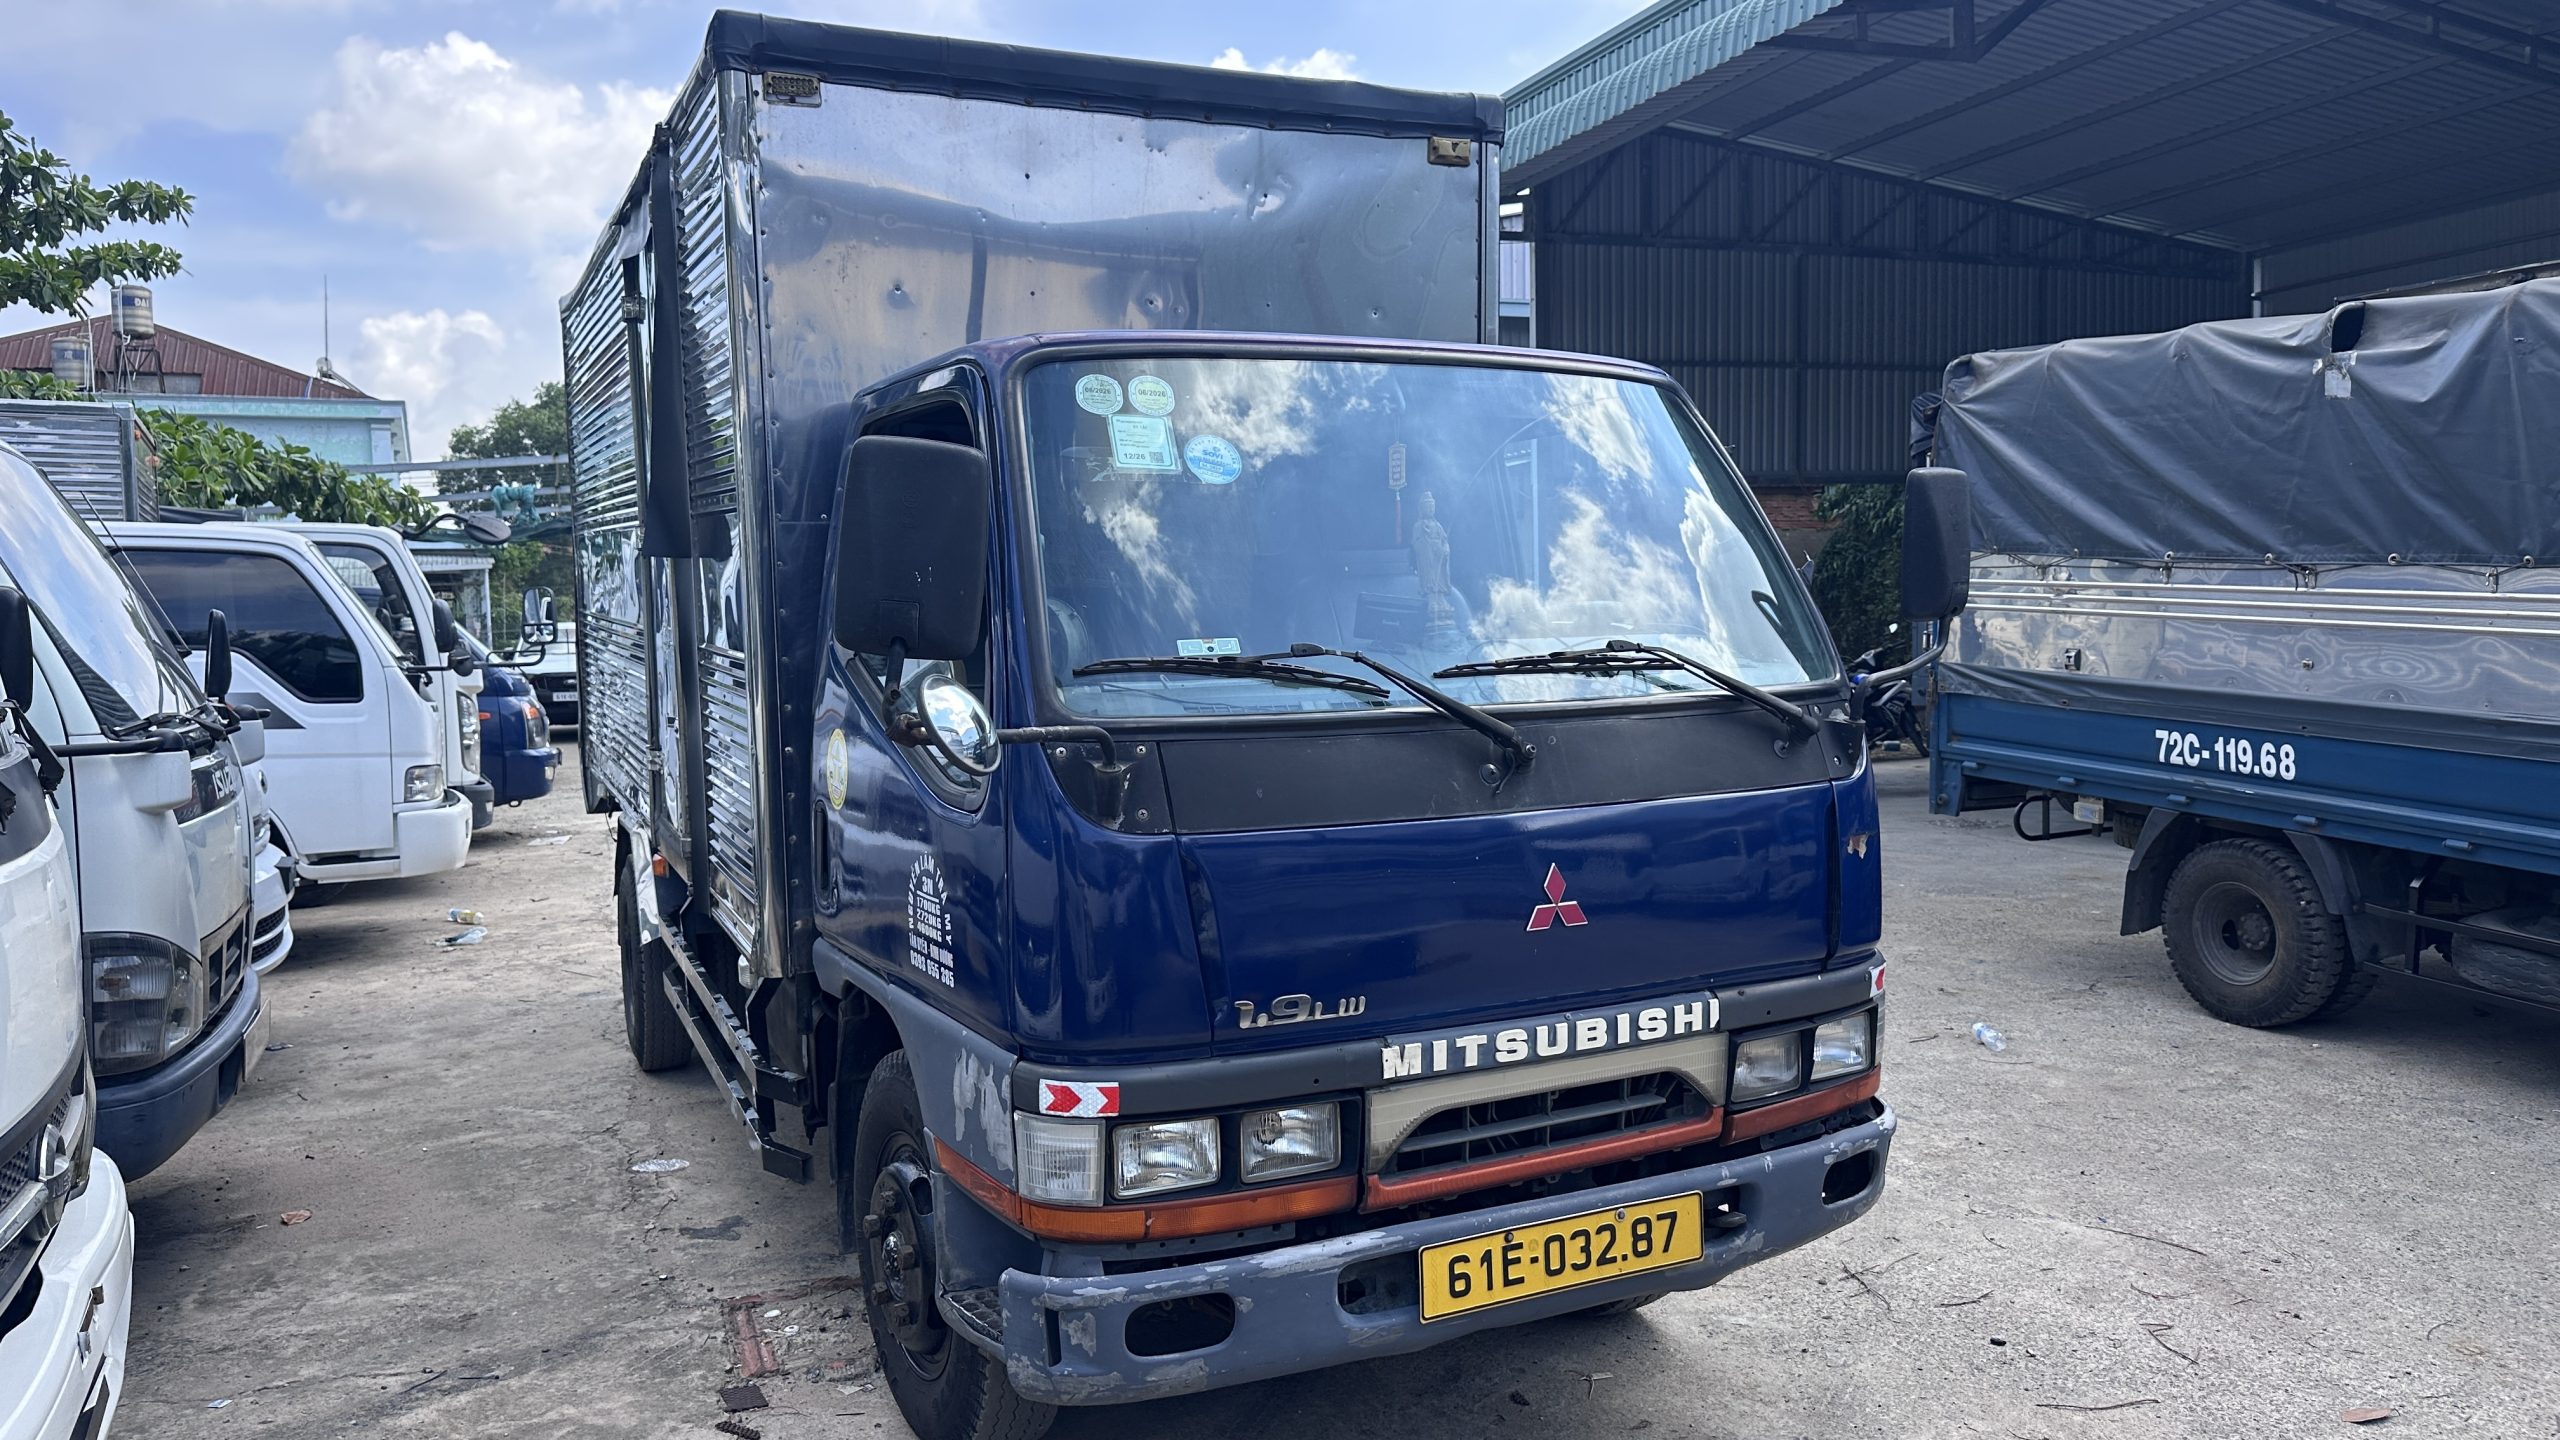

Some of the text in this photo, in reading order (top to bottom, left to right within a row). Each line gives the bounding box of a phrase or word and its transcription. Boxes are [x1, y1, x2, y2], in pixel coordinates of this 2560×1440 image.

[2155, 729, 2296, 781] 72C-119.68
[922, 876, 934, 895] 3N
[917, 896, 941, 915] 1700KG
[917, 908, 942, 929] 2720KG
[1381, 998, 1720, 1080] MITSUBISHI
[1447, 1210, 1679, 1299] 61E-032.87
